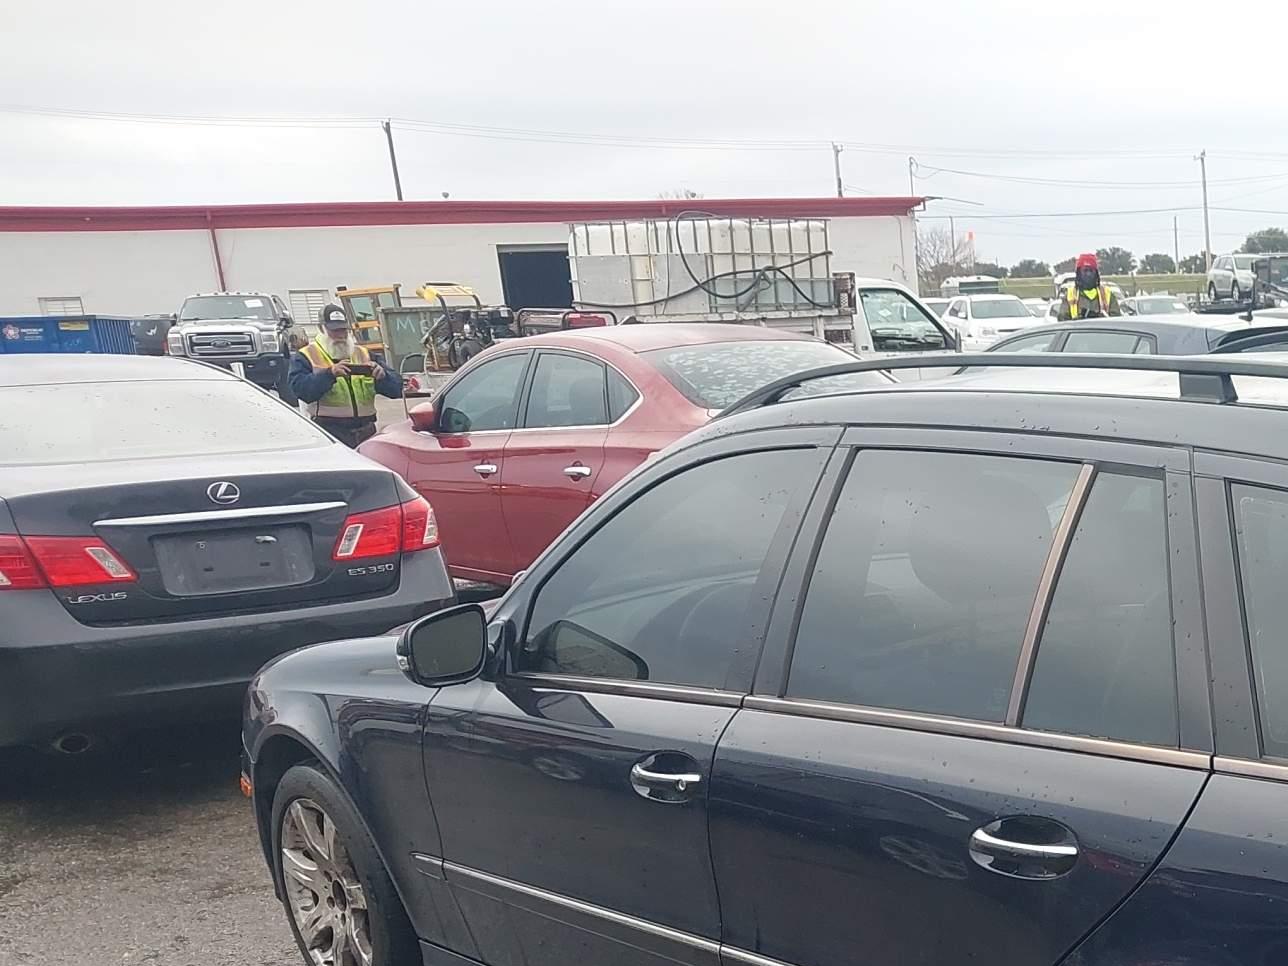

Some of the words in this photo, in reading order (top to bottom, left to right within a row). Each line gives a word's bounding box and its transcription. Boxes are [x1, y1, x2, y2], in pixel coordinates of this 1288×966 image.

[348, 567, 366, 576] ES
[367, 563, 394, 574] 350
[66, 591, 128, 604] LEXUS
